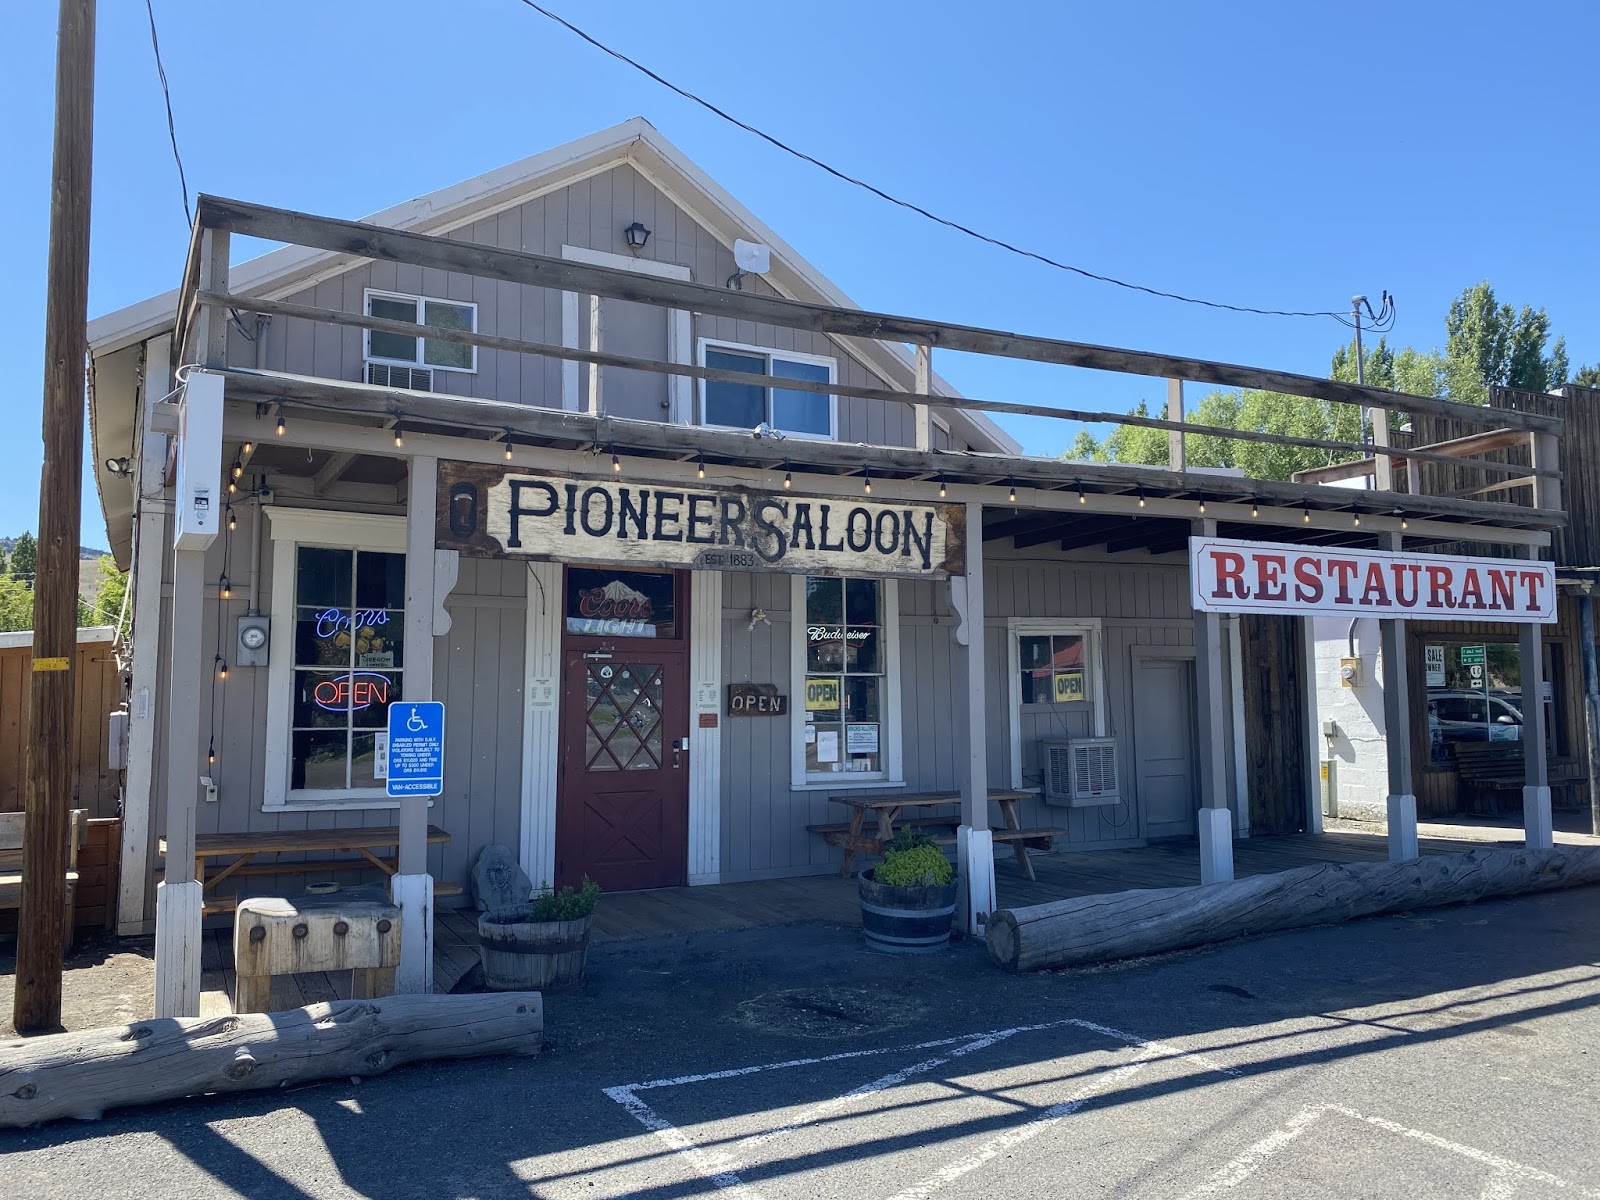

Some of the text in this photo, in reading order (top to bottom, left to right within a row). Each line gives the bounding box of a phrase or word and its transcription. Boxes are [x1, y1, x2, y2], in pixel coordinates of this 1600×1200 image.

[507, 479, 935, 569] PIONEER SALOON
[730, 553, 755, 567] 1883
[1210, 551, 1545, 612] RESTAURANT
[579, 588, 655, 617] Coors
[315, 607, 390, 638] Coors
[583, 618, 649, 634] LIGHT
[807, 626, 871, 640] Budweiser
[1427, 648, 1442, 662] SALE
[1425, 663, 1441, 672] WNER
[315, 681, 387, 704] OPEN
[808, 684, 837, 702] OPEN
[1057, 677, 1081, 695] OPEN
[731, 695, 781, 712] OPEN
